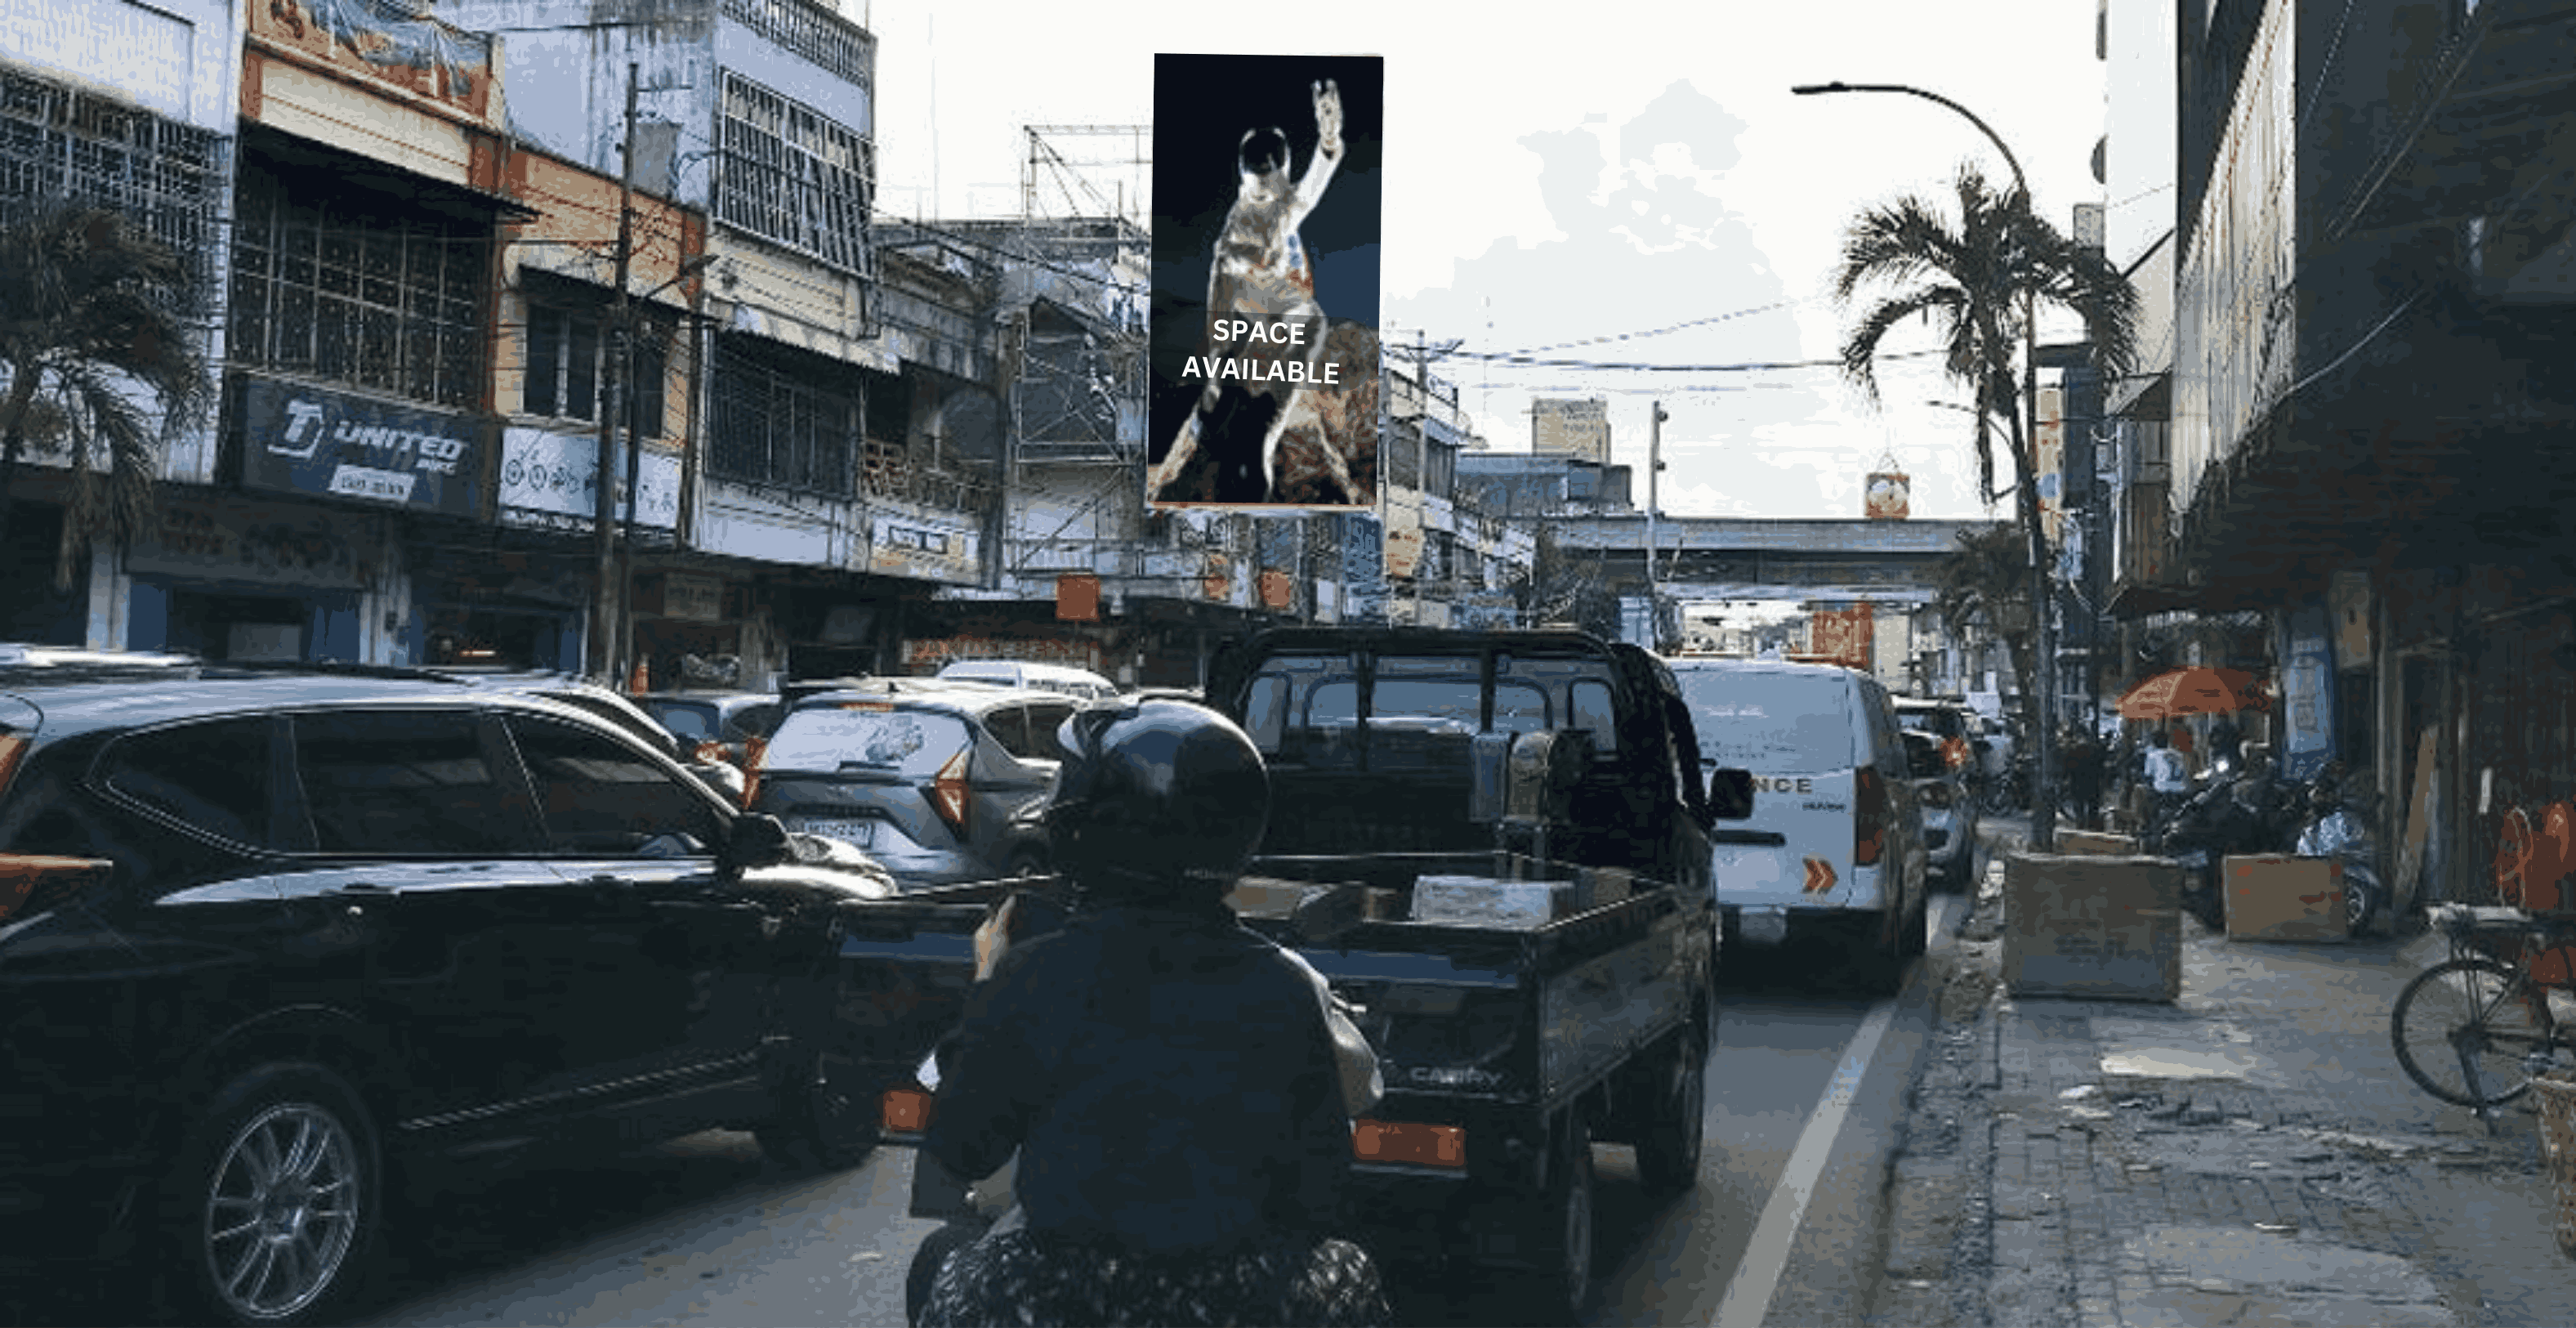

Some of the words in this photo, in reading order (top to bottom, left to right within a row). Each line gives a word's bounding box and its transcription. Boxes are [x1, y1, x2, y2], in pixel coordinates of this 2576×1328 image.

[1213, 319, 1306, 345] SPACE
[1181, 355, 1340, 385] AVAILABLE
[333, 420, 464, 460] UNITED
